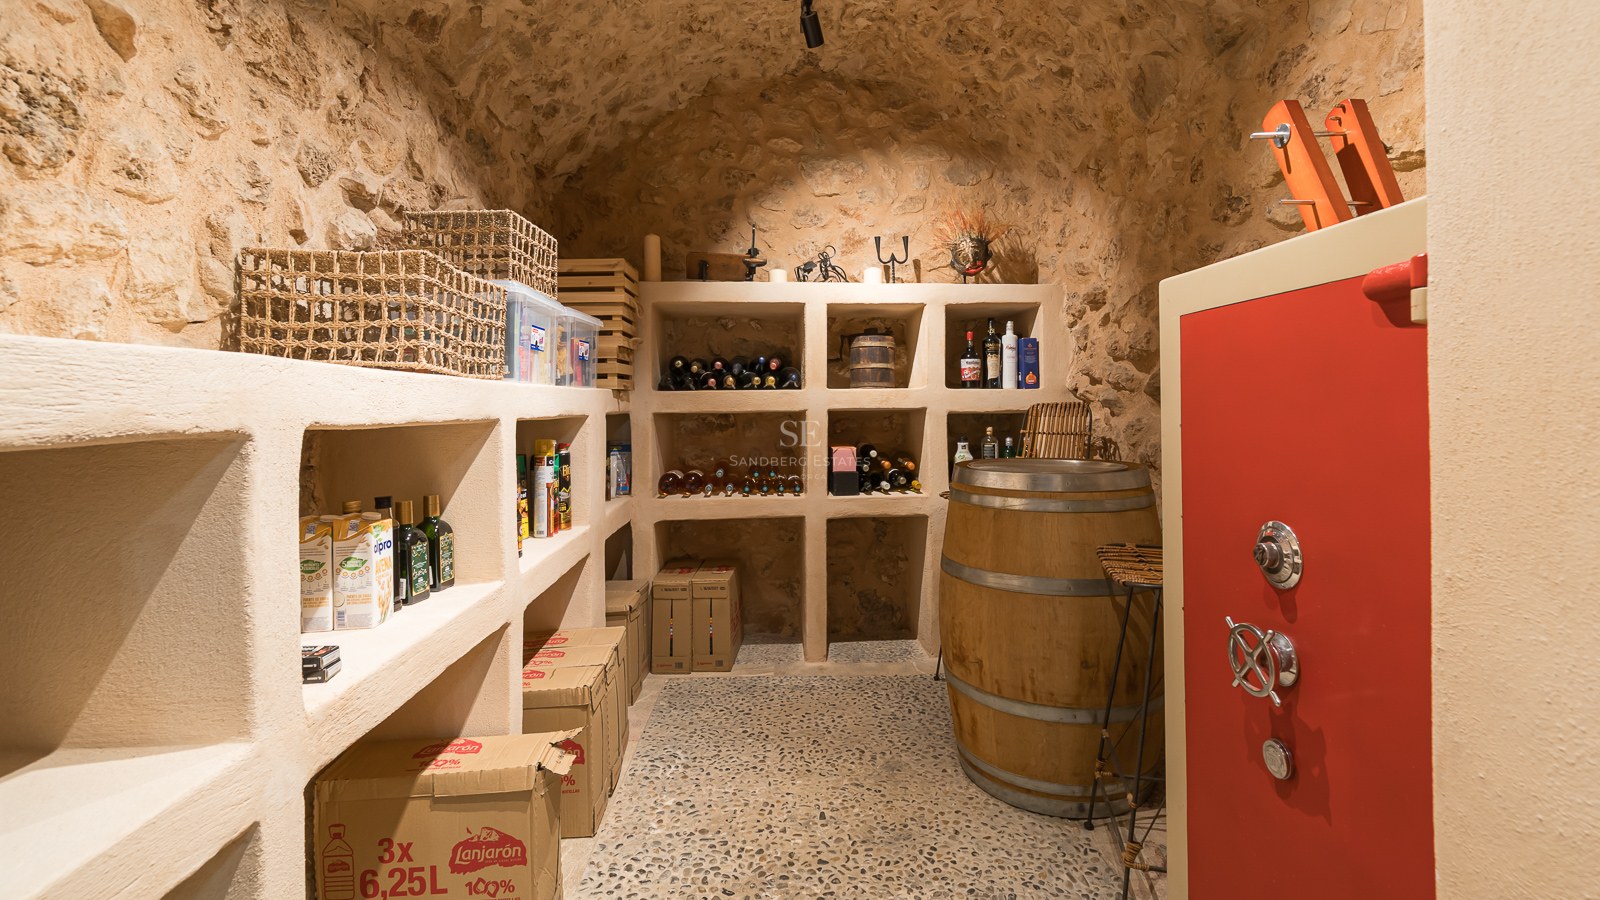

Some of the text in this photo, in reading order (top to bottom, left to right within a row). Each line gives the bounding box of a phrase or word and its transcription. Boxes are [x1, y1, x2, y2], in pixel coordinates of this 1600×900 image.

[374, 540, 392, 555] alpro
[377, 837, 414, 864] 3x
[454, 844, 521, 865] Lanjarón
[359, 865, 448, 900] 6,25L
[465, 877, 515, 898] 100%
